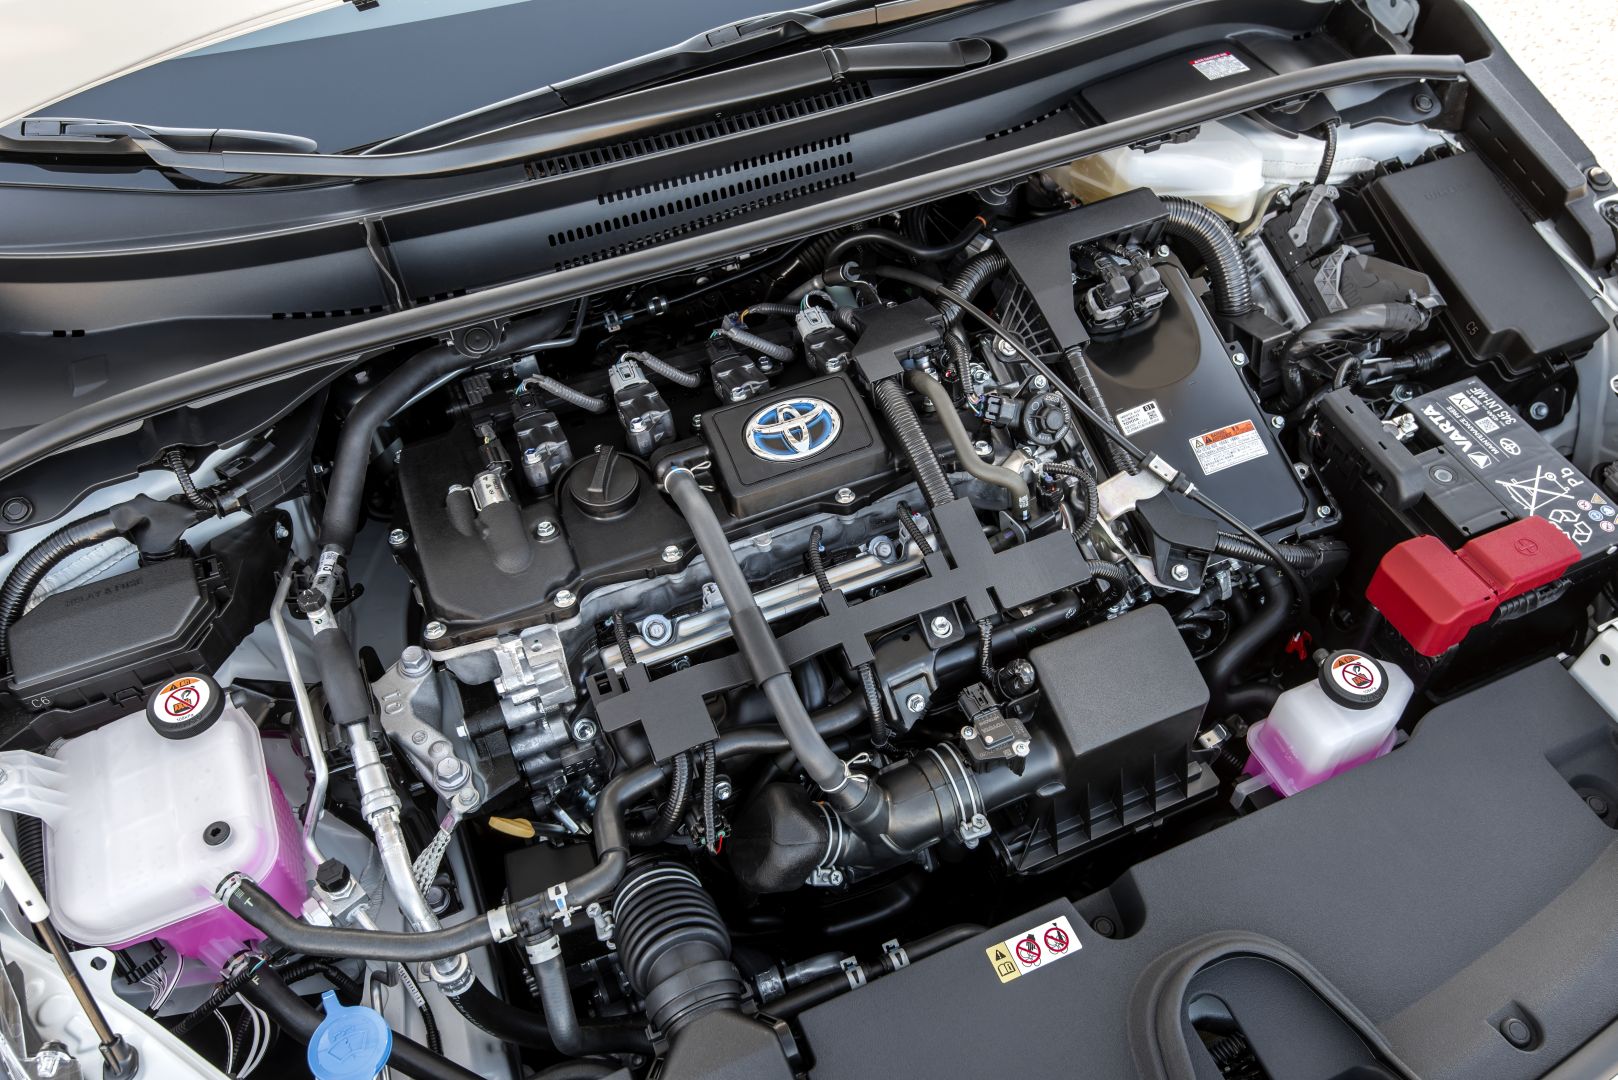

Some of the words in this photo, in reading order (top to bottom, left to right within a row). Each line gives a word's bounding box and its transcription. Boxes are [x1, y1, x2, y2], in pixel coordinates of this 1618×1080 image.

[1466, 321, 1478, 336] C5
[1451, 396, 1475, 411] PY
[1468, 387, 1503, 412] LN1-MF
[1445, 405, 1462, 418] FREE
[1496, 410, 1518, 425] 345
[1423, 404, 1473, 452] VARTA
[1458, 417, 1500, 454] MAINTENANCE
[1561, 468, 1584, 488] Pb
[31, 696, 50, 709] C6
[244, 897, 254, 908] T
[252, 975, 260, 986] F
